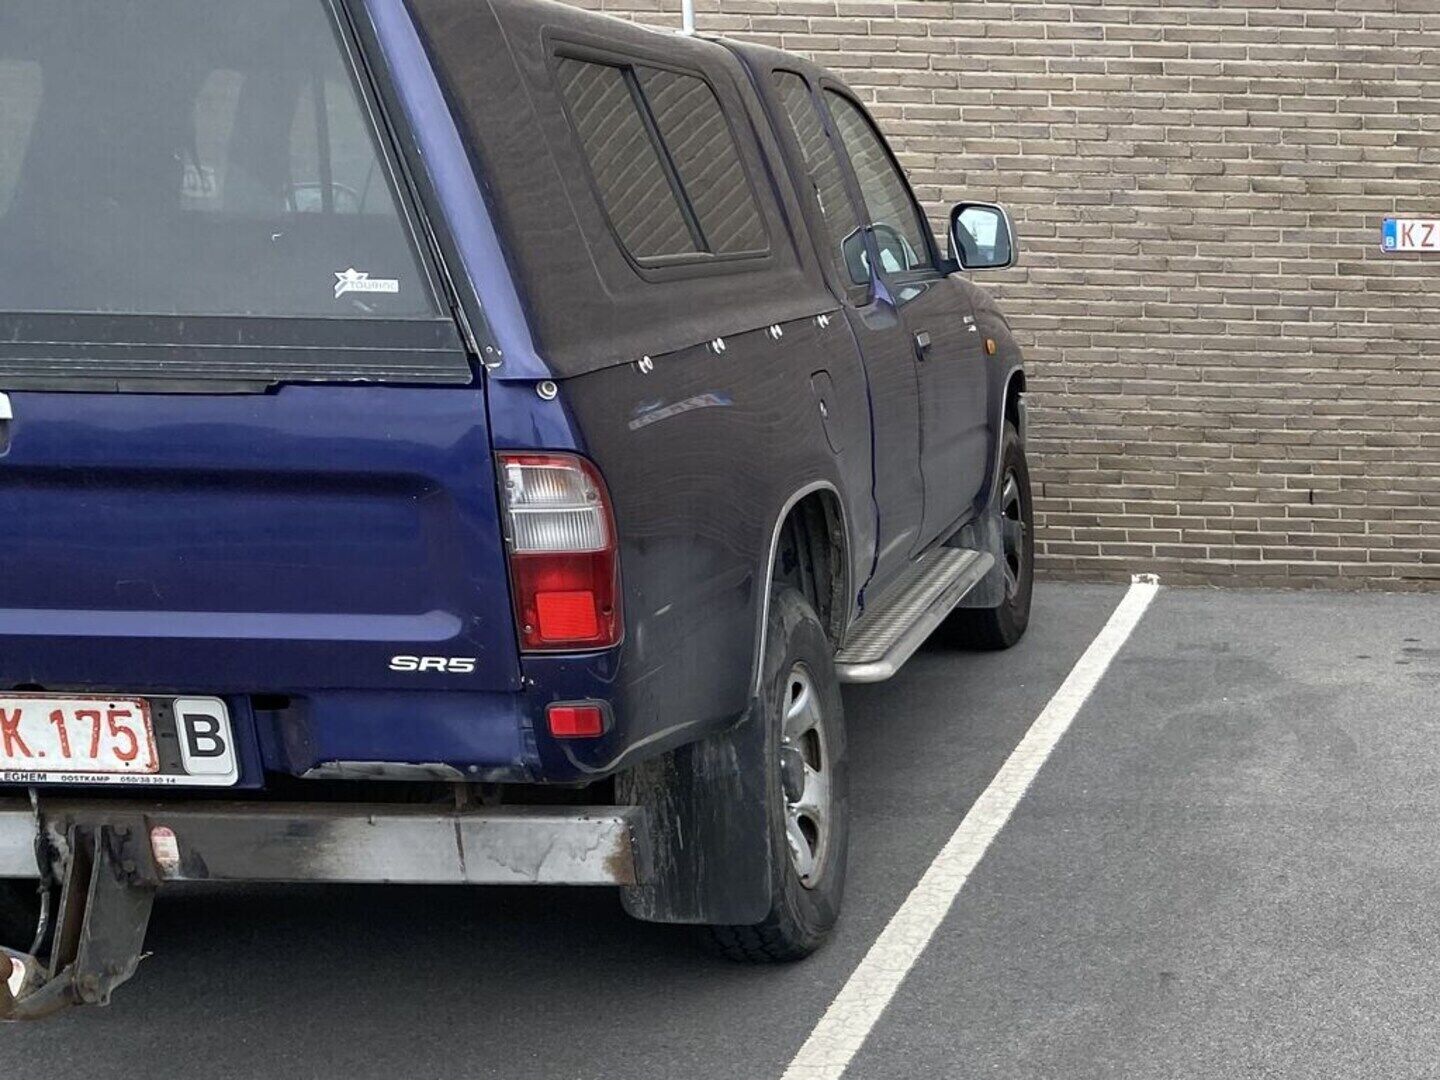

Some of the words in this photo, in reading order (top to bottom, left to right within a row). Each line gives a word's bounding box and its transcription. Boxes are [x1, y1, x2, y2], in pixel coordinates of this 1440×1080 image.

[1385, 236, 1395, 246] B
[389, 655, 476, 672] SR5
[182, 713, 226, 757] B
[0, 771, 47, 782] EGHEM
[61, 774, 110, 783] OOSTKAMP
